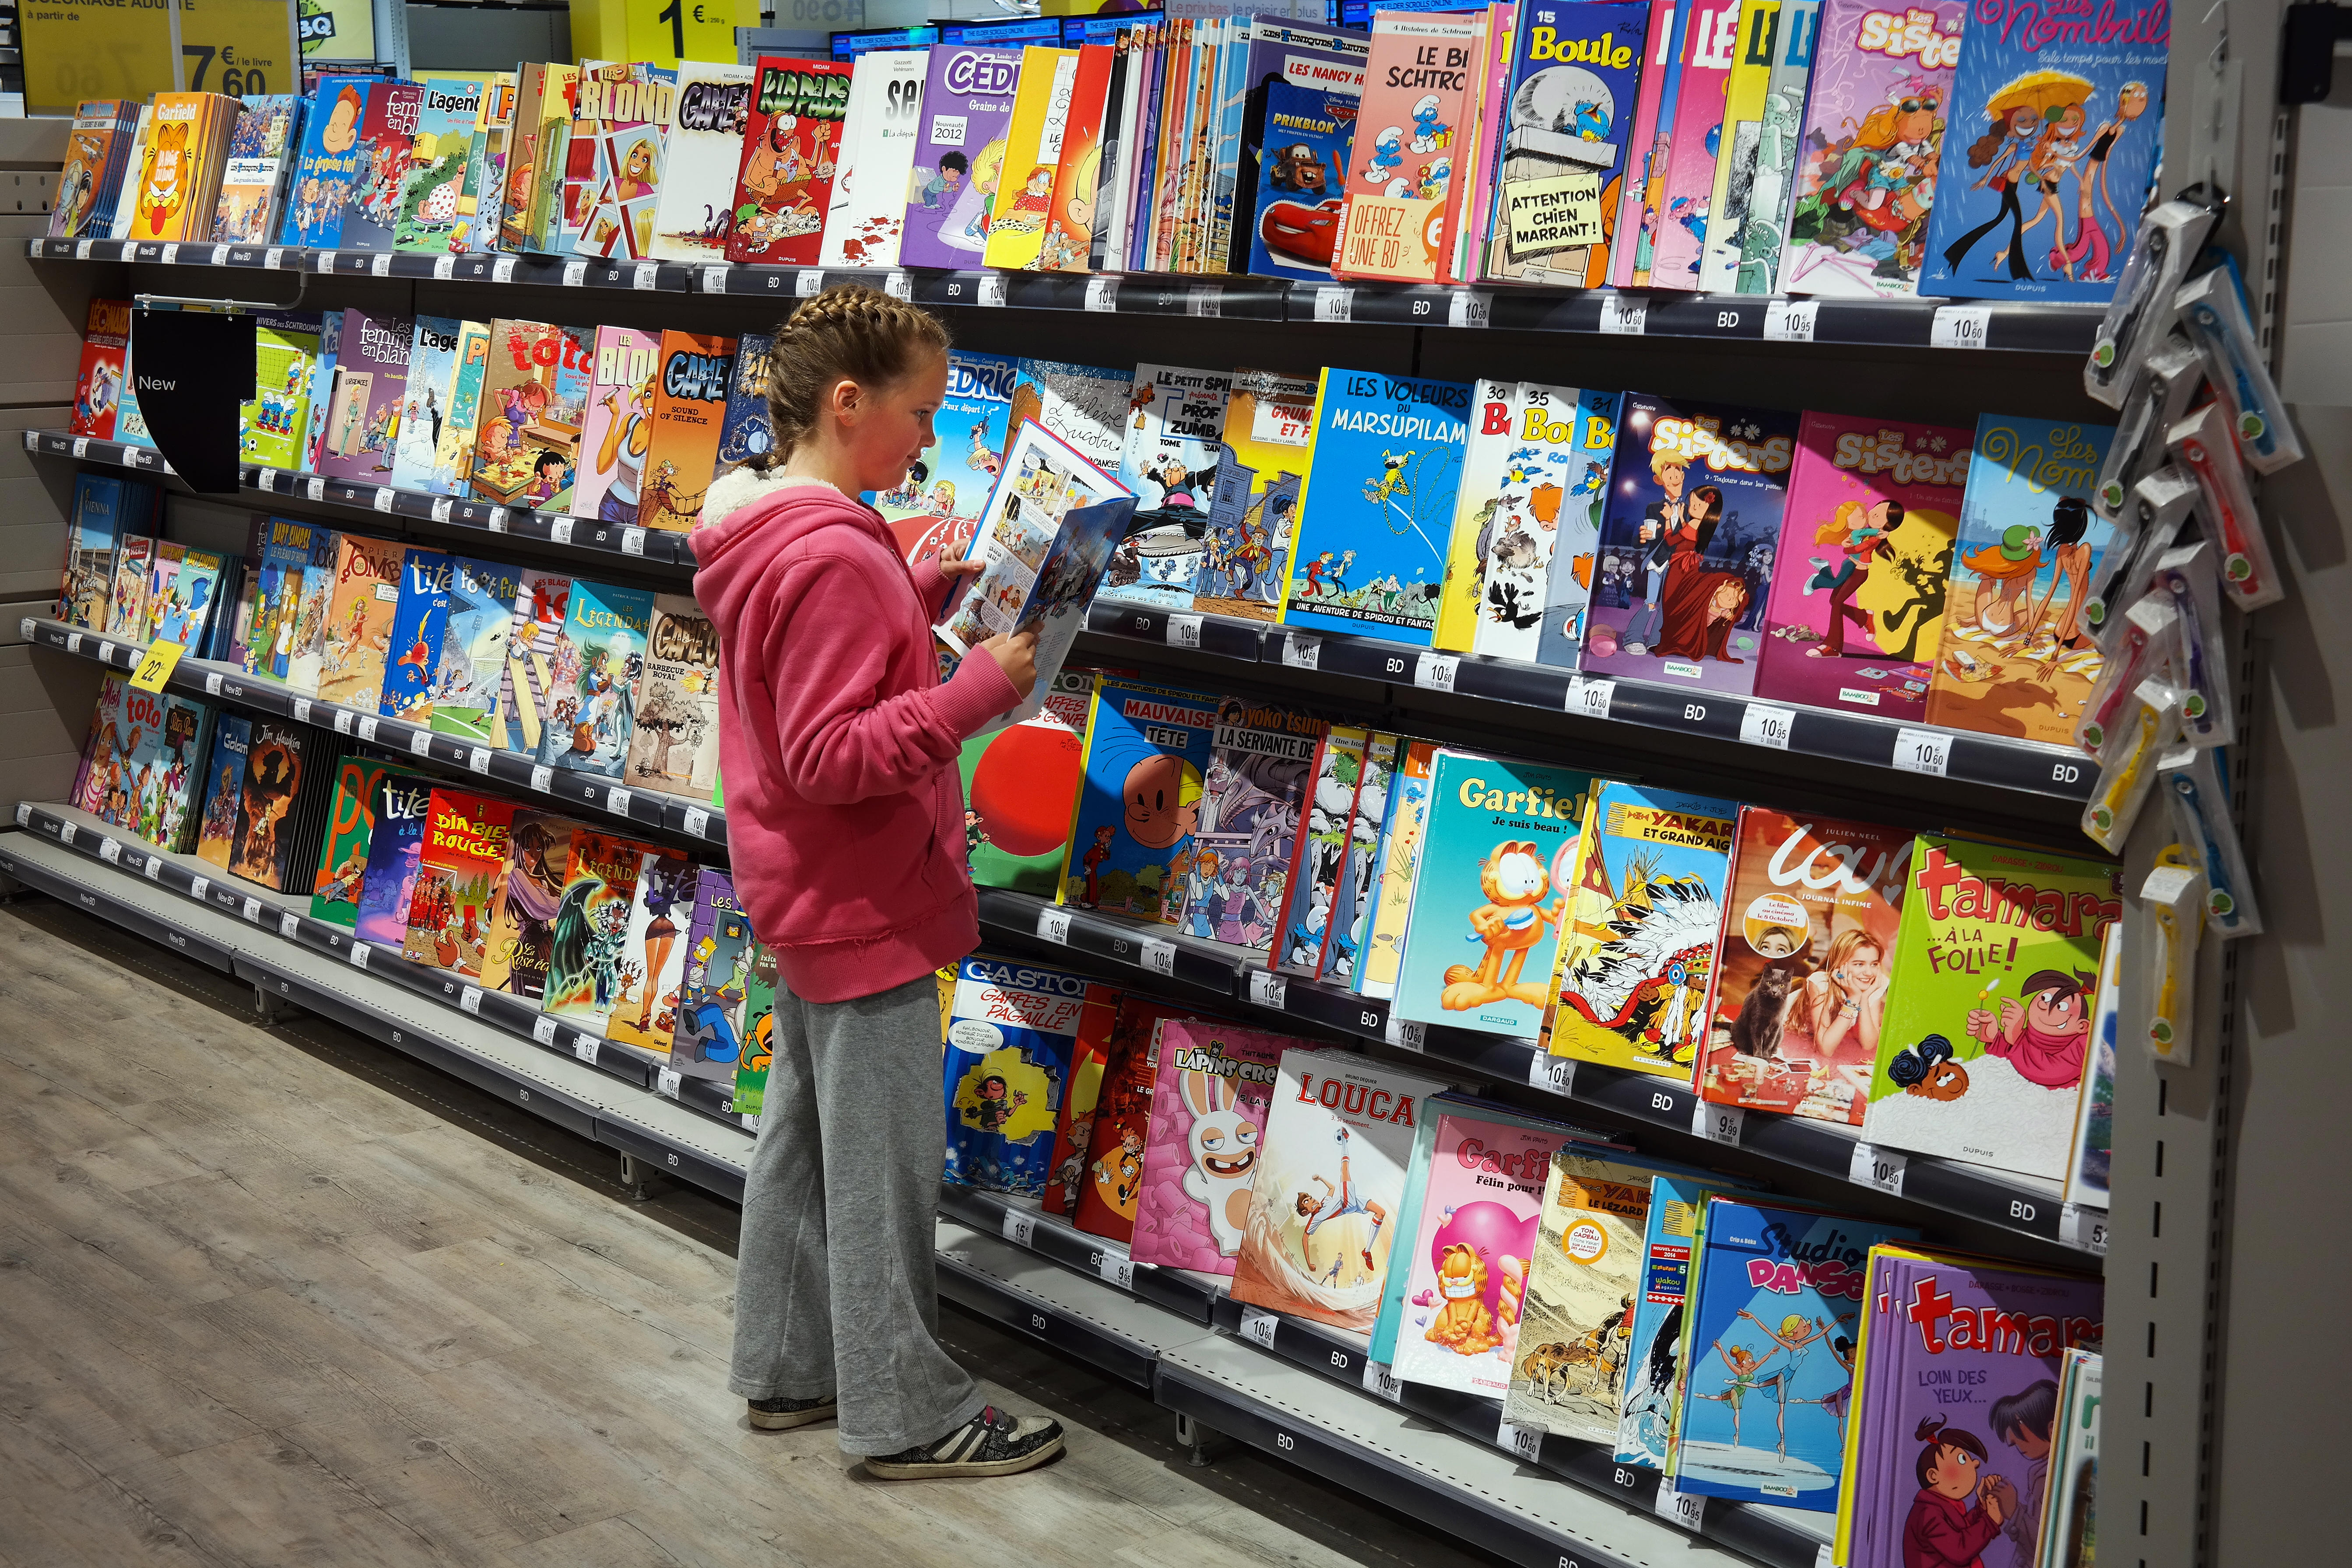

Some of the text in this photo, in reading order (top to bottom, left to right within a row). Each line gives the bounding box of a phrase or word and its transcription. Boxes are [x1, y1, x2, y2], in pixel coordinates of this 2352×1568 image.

[28, 11, 79, 22] à partir de
[1537, 11, 1555, 22] 15
[1264, 29, 1369, 53] LES TUNIQUES BLEUES
[1530, 27, 1632, 68] Boule
[182, 45, 215, 95] 7
[241, 58, 249, 66] le
[253, 58, 272, 67] livre
[604, 70, 618, 80] LES
[1289, 63, 1352, 83] LES NANCY
[222, 70, 265, 95] 60
[157, 103, 197, 121] Garfield
[969, 100, 1009, 112] Graine de
[1273, 113, 1335, 133] PRIKBLOK
[935, 128, 962, 140] 2012
[1512, 187, 1597, 210] ATTENTION
[1355, 206, 1404, 237] OFFREZ
[1517, 224, 1588, 243] MARRANT
[1349, 237, 1399, 268] UNE BD
[355, 259, 363, 268] BD
[609, 271, 618, 281] BD
[948, 284, 960, 295] BD
[1718, 312, 1739, 327] BD
[138, 376, 176, 391] New
[345, 379, 368, 387] URGENCES
[666, 352, 727, 401] GAME
[1156, 372, 1201, 387] LE PETIT
[1348, 377, 1468, 407] LES VOLEURS
[1488, 386, 1506, 400] 30
[1529, 391, 1549, 406] 35
[671, 407, 699, 415] SOUND
[943, 401, 985, 414] Faux départ !
[1049, 392, 1124, 428] L'élève
[1181, 404, 1218, 419] PROF
[1397, 404, 1411, 412] DU
[673, 415, 708, 425] SILENCE
[1046, 417, 1120, 452] Ducobu
[1160, 438, 1181, 448] TOME
[84, 502, 109, 515] VIENNA
[597, 531, 606, 541] BD
[1296, 602, 1310, 611] UNE
[1313, 603, 1350, 617] AVENTURE
[1365, 611, 1394, 622] SPIROU
[59, 635, 64, 645] BD
[647, 663, 685, 676] BARBECUE
[653, 672, 676, 681] ROYAL
[234, 685, 242, 696] BD
[127, 695, 161, 726] toto
[1124, 700, 1215, 728] MAUVAISE
[1685, 704, 1706, 721] BD
[256, 725, 301, 751] Jim Hawkins
[1148, 725, 1187, 748] TÊTE
[1219, 728, 1314, 758] LA SERVANTE DE
[1492, 817, 1568, 833] Je suis beau !
[1643, 828, 1658, 839] ET
[1660, 830, 1703, 845] GRAND
[1826, 828, 1881, 841] JULIEN NEEL
[81, 893, 95, 905] New BD
[711, 893, 732, 909] Les
[1802, 893, 1872, 908] JOURNAL INFIME
[444, 983, 453, 994] BD
[980, 989, 1050, 1010] GAFFES
[986, 1005, 1070, 1030] PAGAILLE
[1361, 1012, 1378, 1027] BD
[1482, 1016, 1515, 1025] DARGAUD
[1298, 1074, 1415, 1126] LOUCA
[1476, 1175, 1534, 1194] Félin pour
[1588, 1199, 1643, 1216] LE LÉZARD
[1573, 1231, 1599, 1240] CADEAU
[1330, 1351, 1347, 1368] BD
[1918, 1370, 1987, 1387] LOIN DES
[1278, 1433, 1293, 1450] BD
